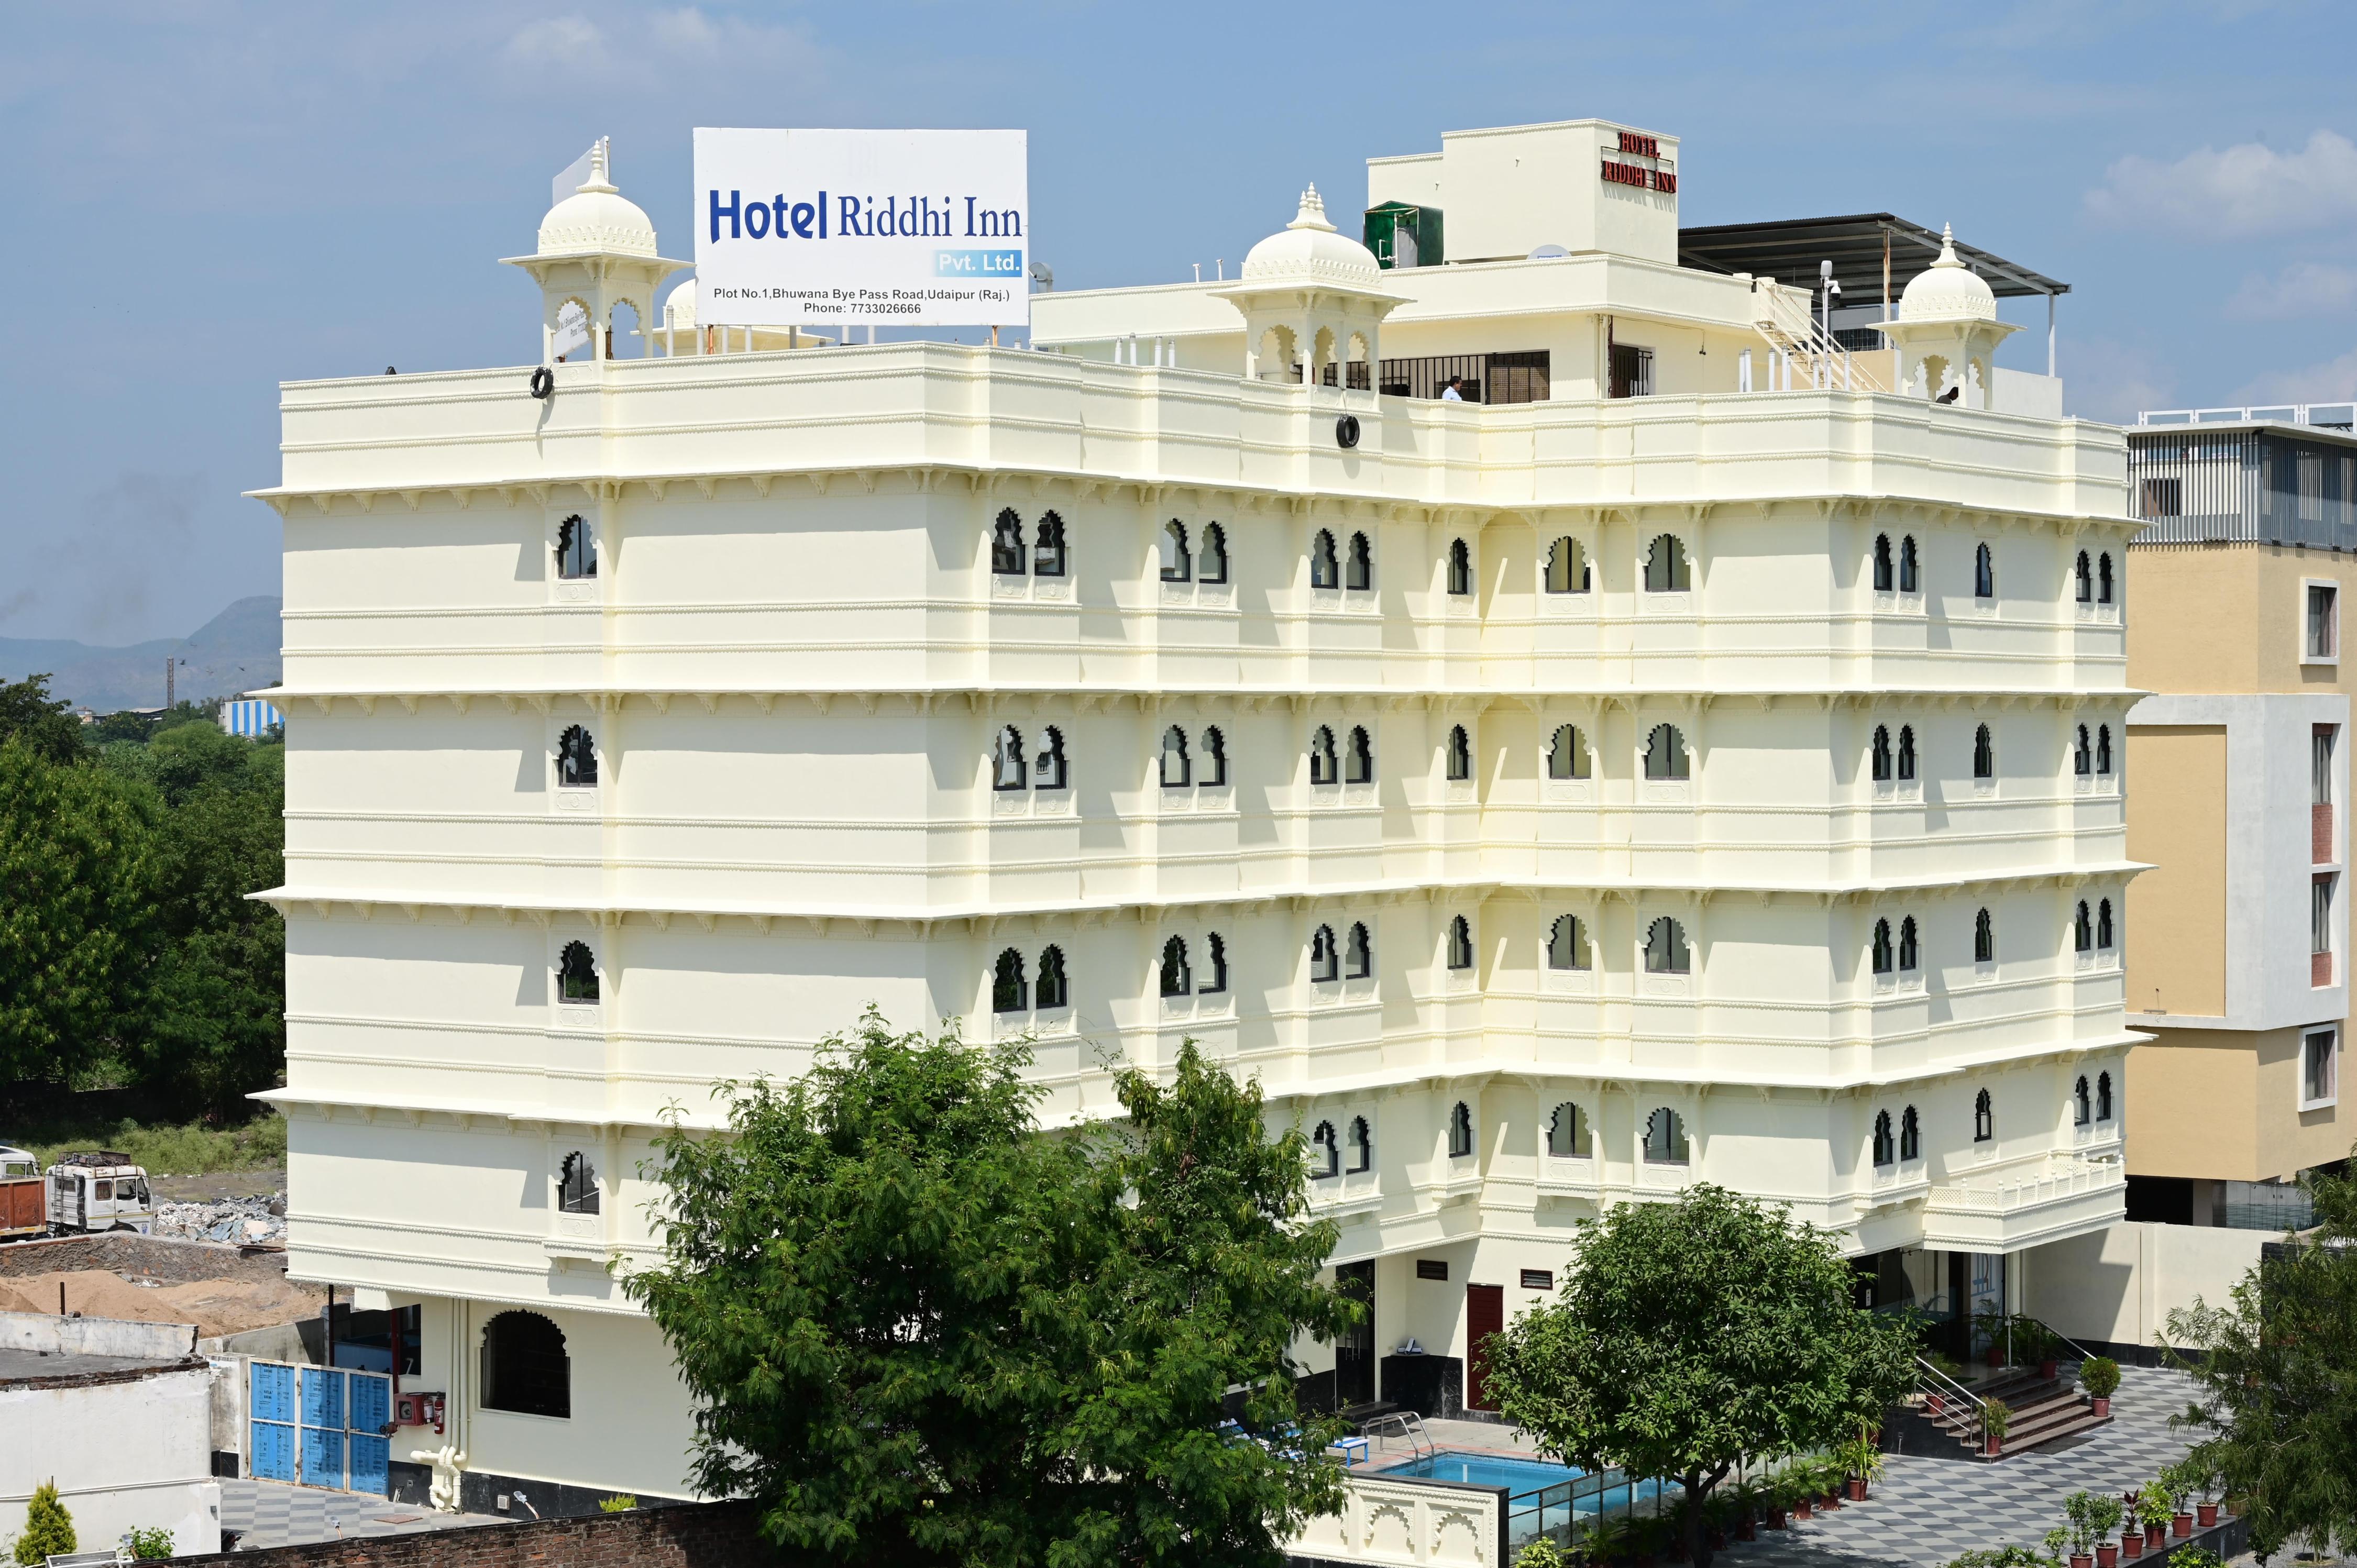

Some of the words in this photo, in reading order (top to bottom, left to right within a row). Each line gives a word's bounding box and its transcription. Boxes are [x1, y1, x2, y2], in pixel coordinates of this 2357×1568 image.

[1620, 131, 1660, 158] HOTEL
[1603, 160, 1648, 188] RIDDHI
[1654, 171, 1677, 193] INN
[710, 190, 827, 245] Hotel
[838, 195, 953, 237] Riddhi
[964, 196, 1022, 237] Inn
[939, 253, 976, 271] Pvt.
[983, 253, 1020, 271] Ltd.
[714, 288, 737, 299] Plot
[742, 288, 828, 301] No.1,Bhuwana
[833, 289, 855, 302] Bye
[860, 289, 888, 300] Pass
[893, 289, 975, 302] Road,Udaipur
[979, 290, 1010, 303] (Raj.)
[804, 303, 846, 313] Phone:
[851, 303, 921, 314] 7733026666
